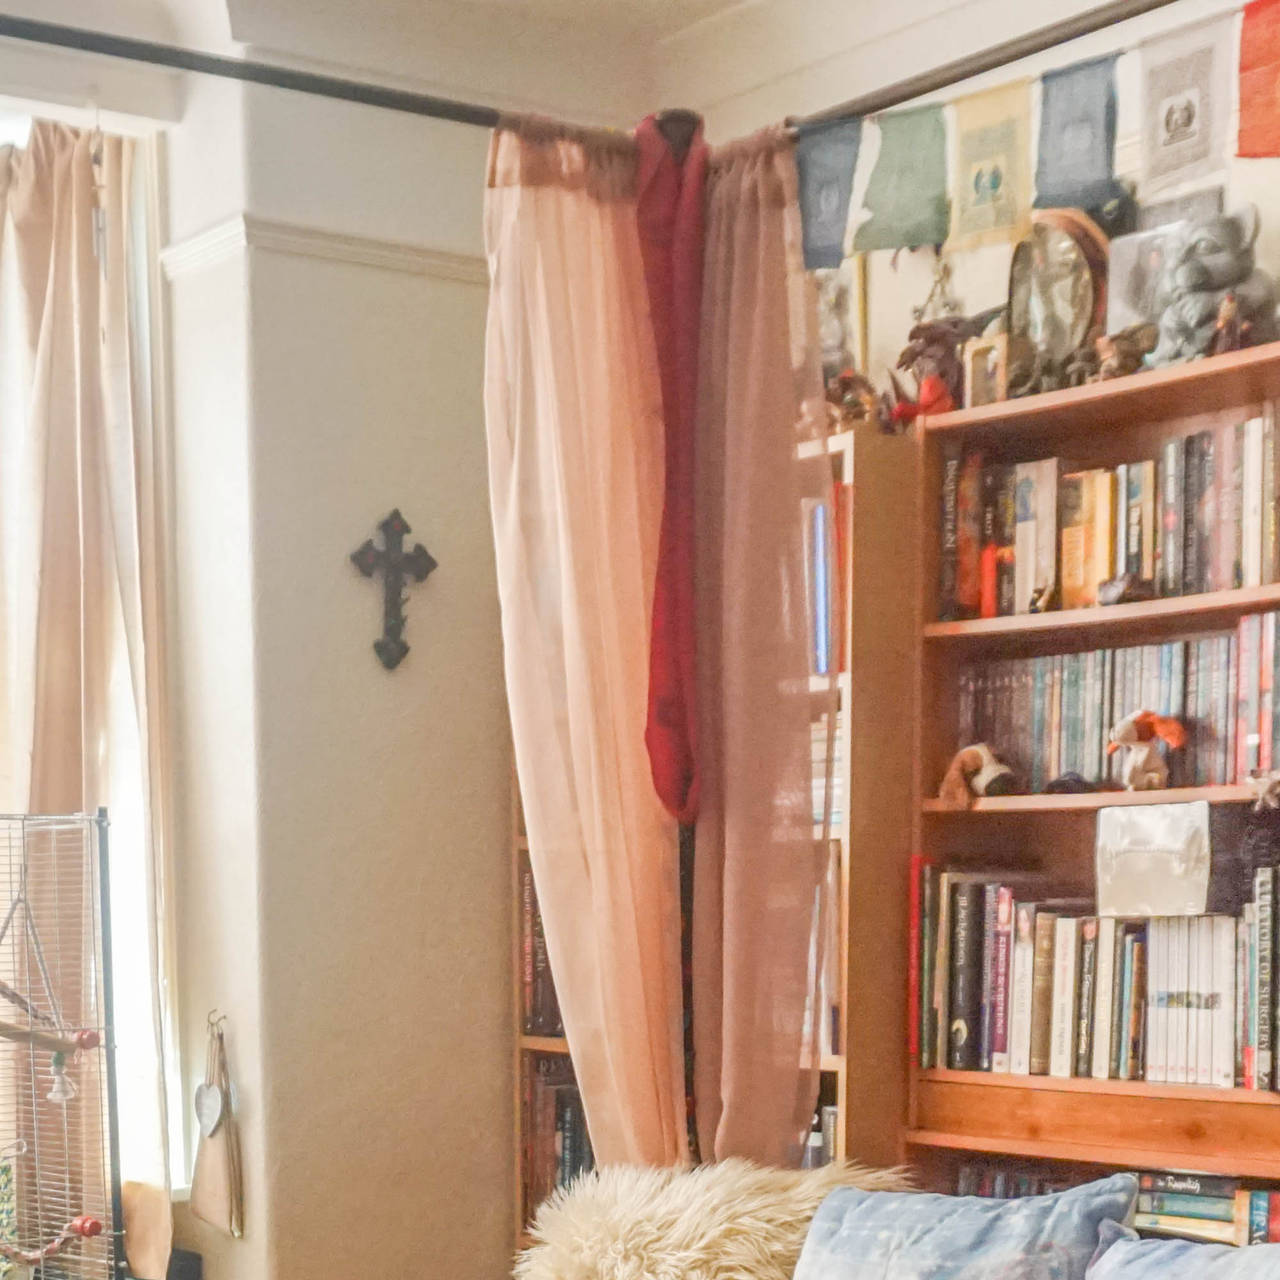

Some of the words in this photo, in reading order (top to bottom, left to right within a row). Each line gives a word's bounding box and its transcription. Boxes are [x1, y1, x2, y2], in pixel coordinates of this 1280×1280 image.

[998, 935, 1007, 971] KINGS
[1259, 962, 1271, 979] OF
[996, 987, 1006, 1035] QUEENS
[1258, 985, 1270, 1051] SURGERY
